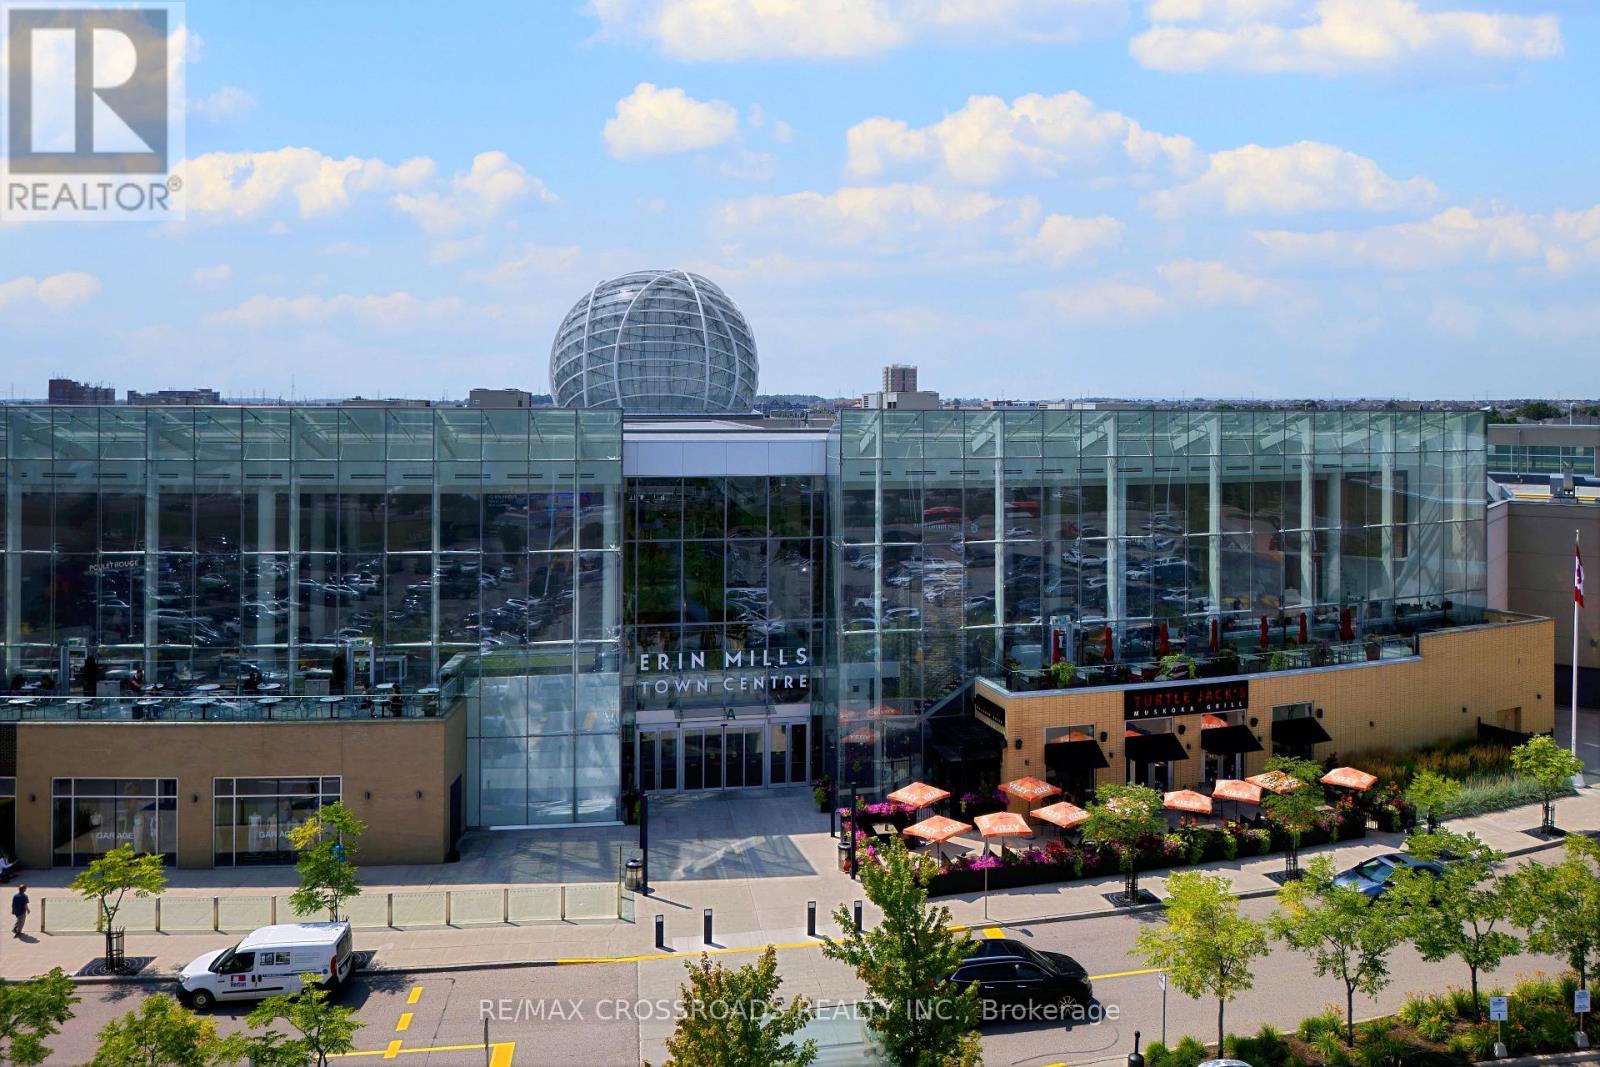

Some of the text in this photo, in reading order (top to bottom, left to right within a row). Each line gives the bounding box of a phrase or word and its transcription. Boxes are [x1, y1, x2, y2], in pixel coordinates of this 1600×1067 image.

[115, 560, 138, 568] ROUGE
[640, 648, 808, 671] ERIN MILLS
[641, 675, 807, 694] TOWN CENTRE
[1134, 688, 1246, 708] TURTLE JACK'S
[726, 708, 736, 720] A
[1133, 701, 1243, 717] MUSKOKA GRILL
